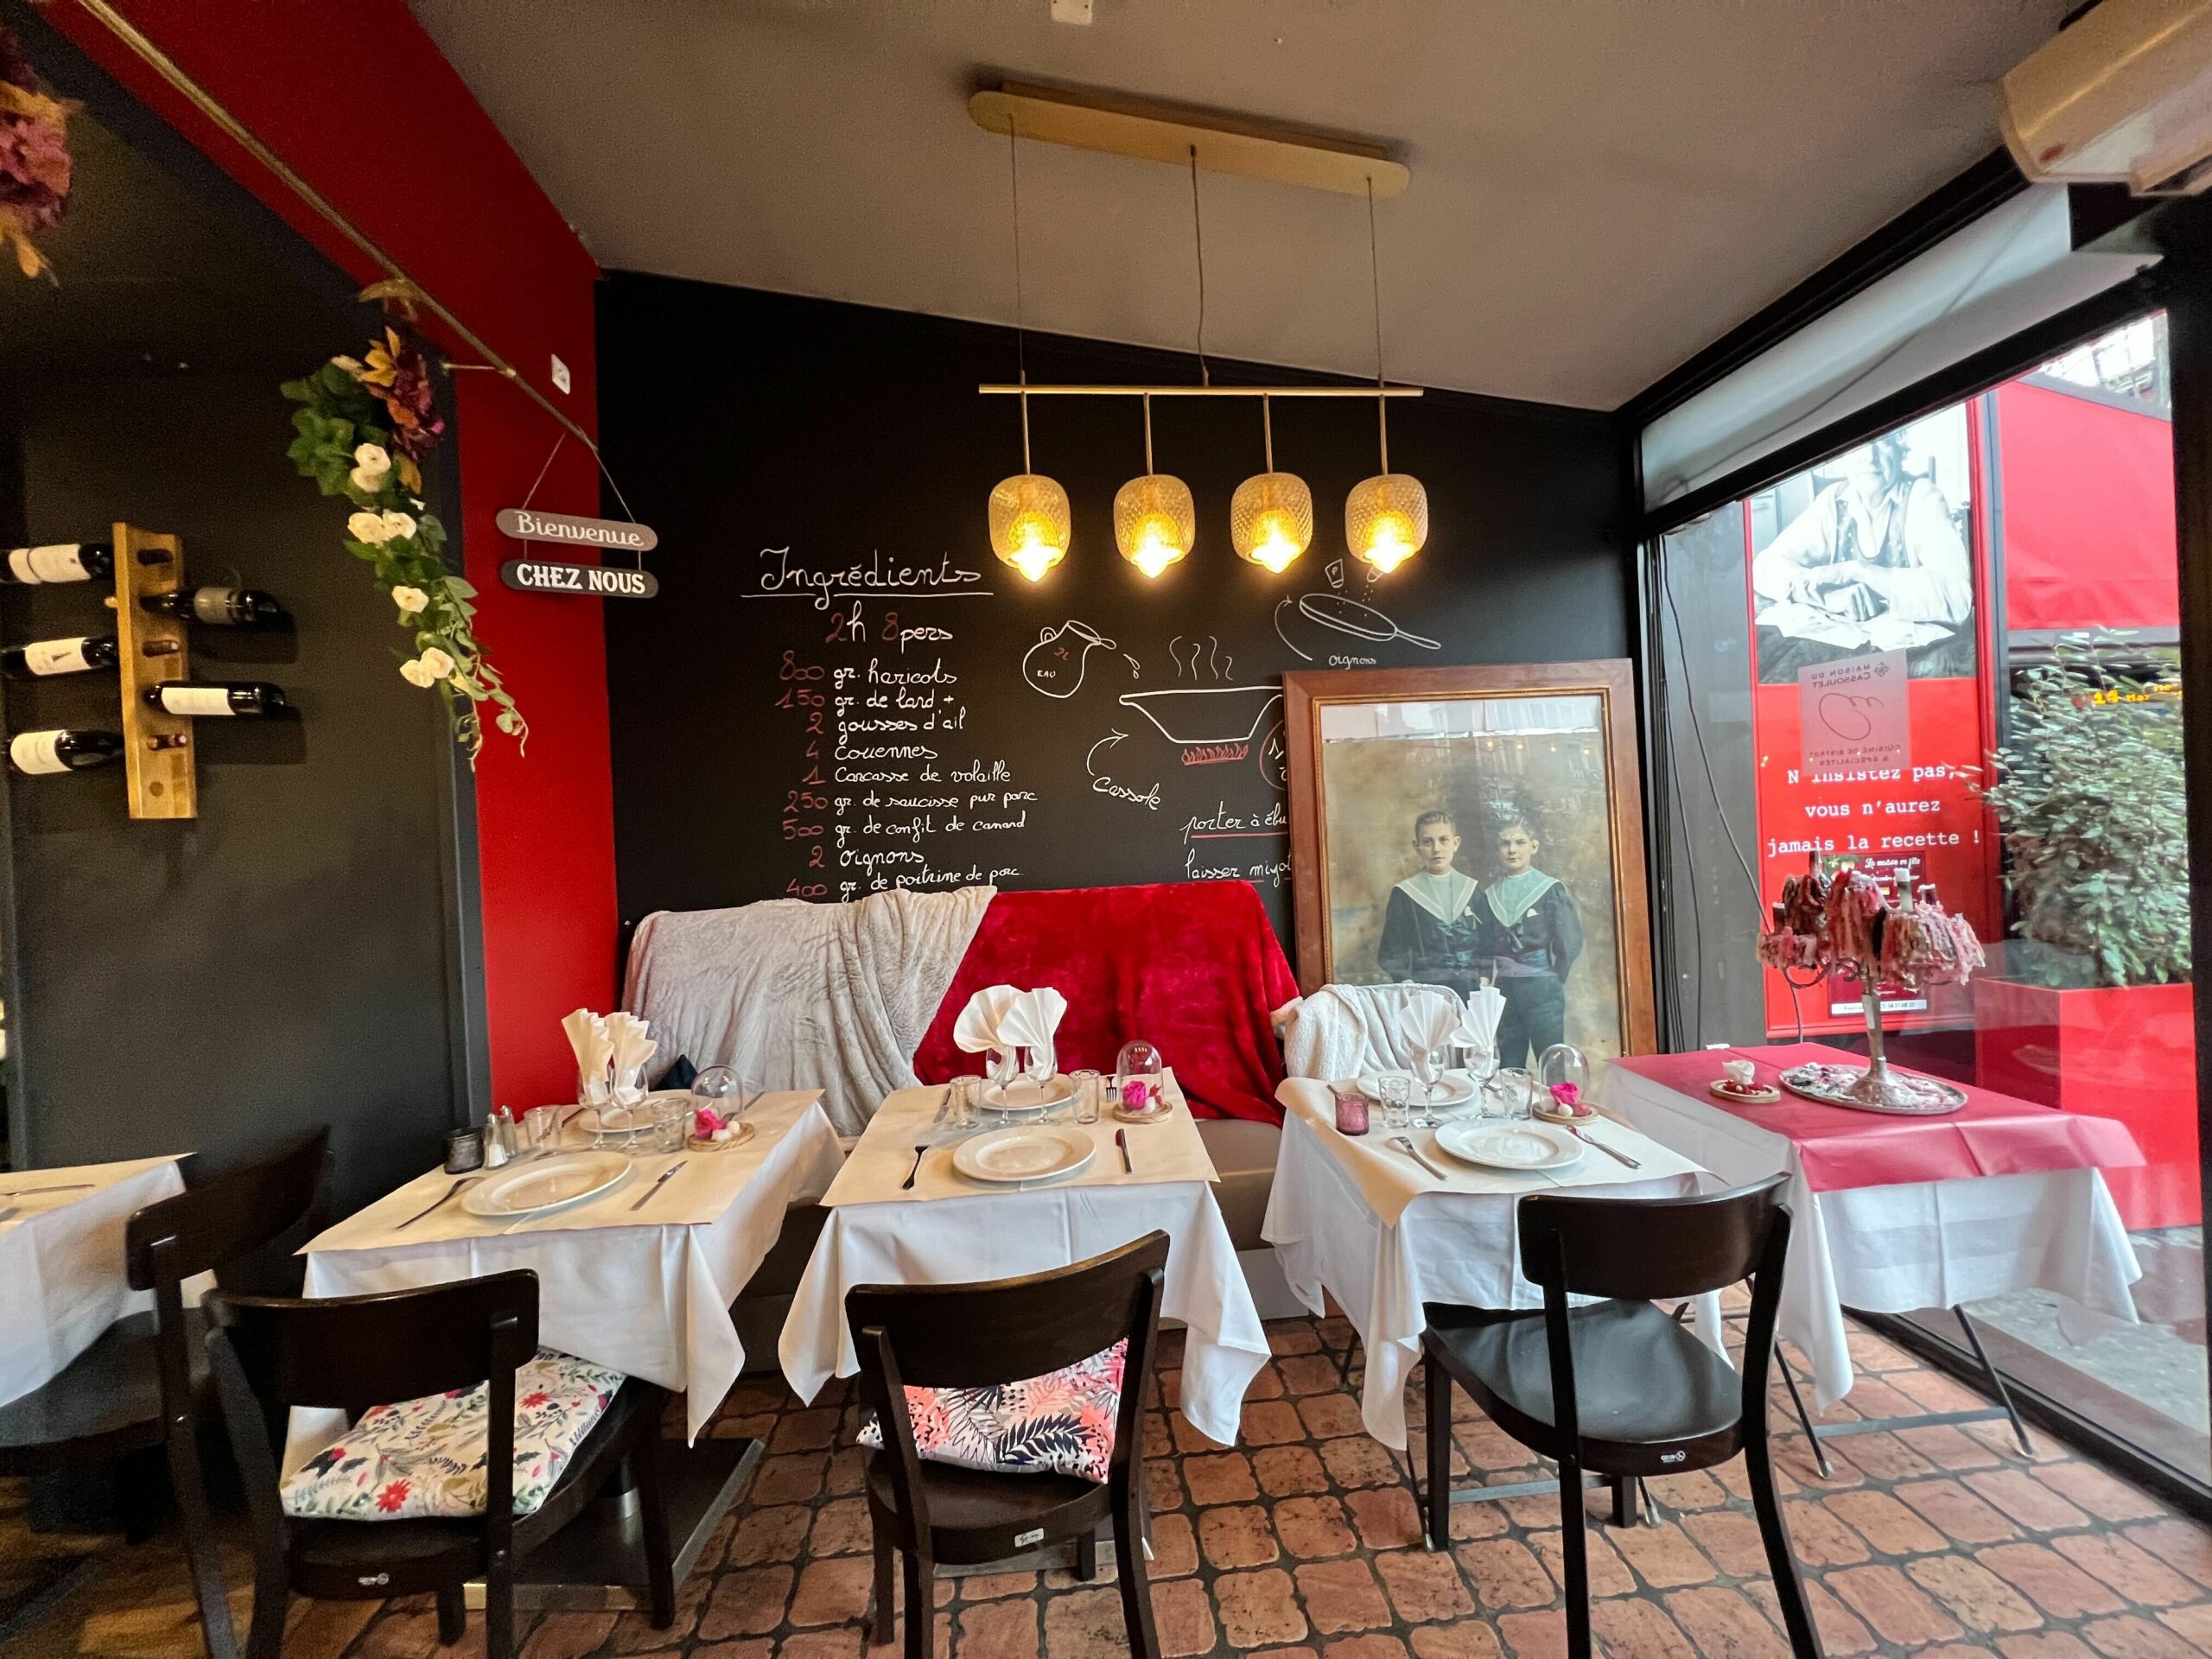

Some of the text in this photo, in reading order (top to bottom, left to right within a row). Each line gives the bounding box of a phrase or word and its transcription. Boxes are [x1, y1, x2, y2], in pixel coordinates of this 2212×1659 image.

[513, 510, 645, 548] Bienvenue
[516, 563, 646, 595] CHEZ NOUS
[759, 544, 983, 610] Ingrédients
[779, 650, 825, 681] 800
[868, 658, 957, 684] haricots
[776, 690, 824, 709] 150
[867, 690, 887, 708] de
[896, 686, 934, 709] lard
[806, 712, 824, 734] 2
[838, 720, 918, 745] gousses
[804, 740, 820, 760] 4
[802, 766, 825, 785] 1
[920, 764, 941, 782] de
[951, 760, 1010, 782] volaille
[784, 791, 828, 812] 250
[863, 790, 880, 807] de
[886, 797, 958, 807] saucisse
[970, 793, 995, 809] pur
[1803, 798, 1942, 819] vous n'aurez
[783, 819, 823, 840] 500
[863, 815, 881, 833] de
[886, 815, 936, 842] confit
[945, 815, 964, 831] de
[973, 810, 1026, 830] canard
[1179, 801, 1247, 844] porter
[1250, 814, 1260, 826] à
[809, 845, 823, 867] 2
[1765, 828, 1981, 858] jamais la recette !
[1185, 848, 1240, 879] laisser
[785, 879, 828, 898] 400
[870, 872, 888, 891] de
[896, 864, 963, 889] poitrine
[966, 865, 982, 880] de
